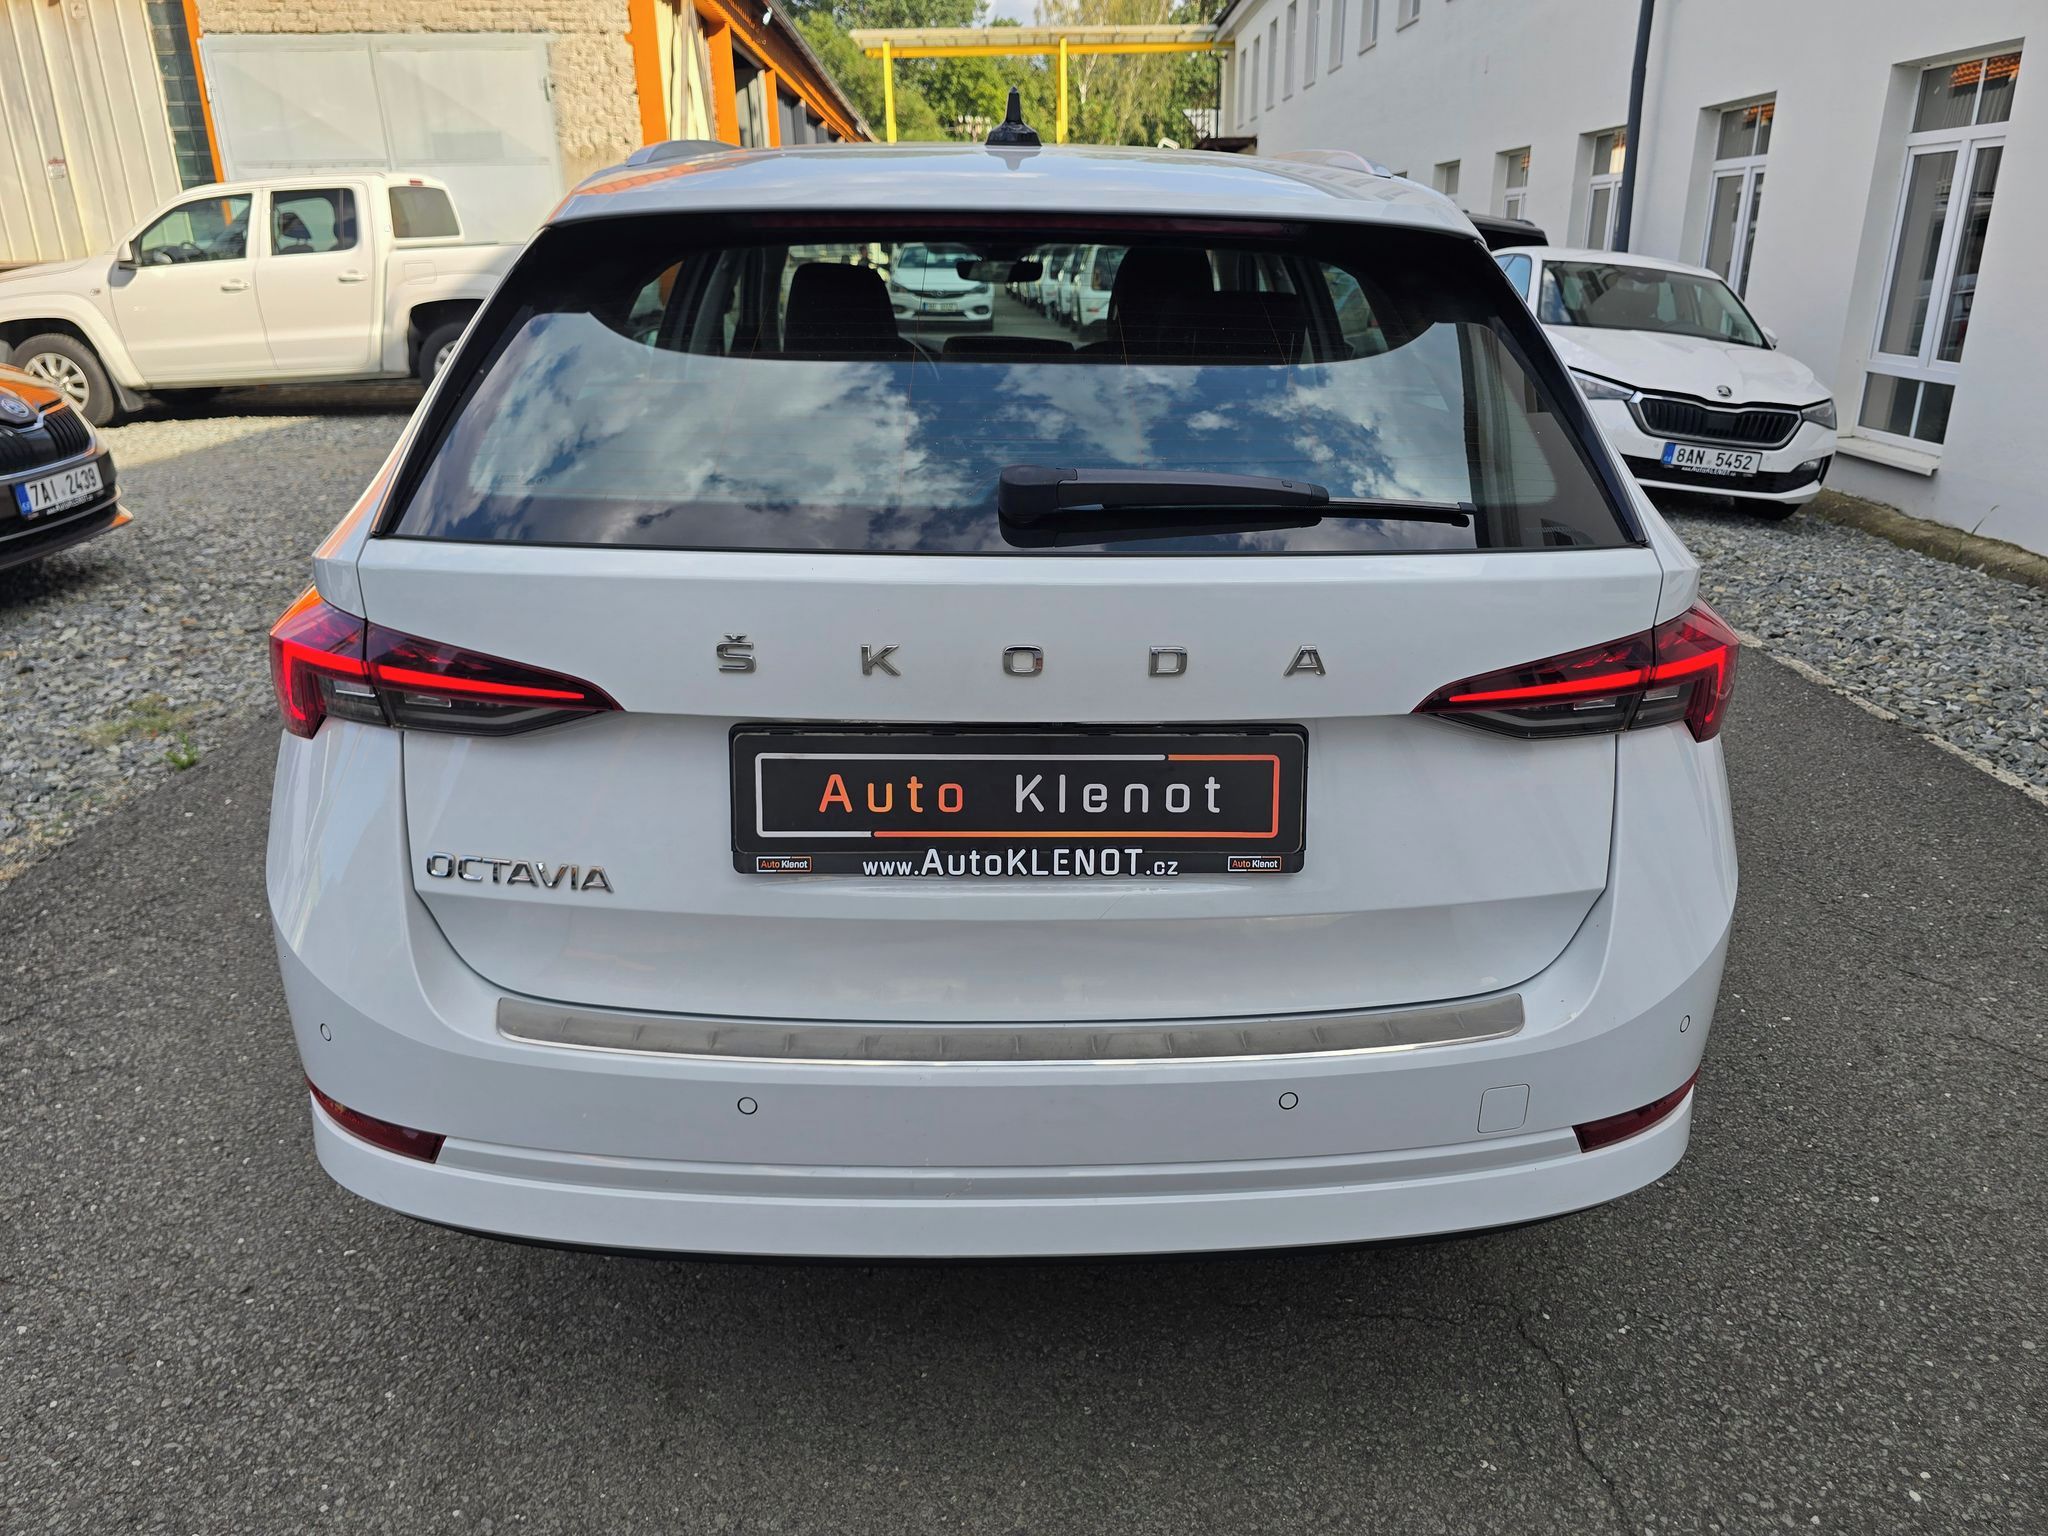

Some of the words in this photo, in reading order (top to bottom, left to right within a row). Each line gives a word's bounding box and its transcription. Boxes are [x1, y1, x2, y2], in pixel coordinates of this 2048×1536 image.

[1676, 448, 1706, 465] 8AN
[1715, 452, 1752, 470] 5452
[66, 467, 97, 494] 2439
[716, 633, 1327, 678] ŠKODA
[818, 773, 965, 814] Auto
[1015, 773, 1222, 815] Klenot
[426, 851, 614, 893] OCTAVIA
[761, 860, 780, 869] Auto
[781, 860, 808, 869] Klenot
[862, 848, 1179, 876] www.AutoKLENOT.cz
[1232, 859, 1251, 868] Auto
[1252, 859, 1278, 868] Klenot
